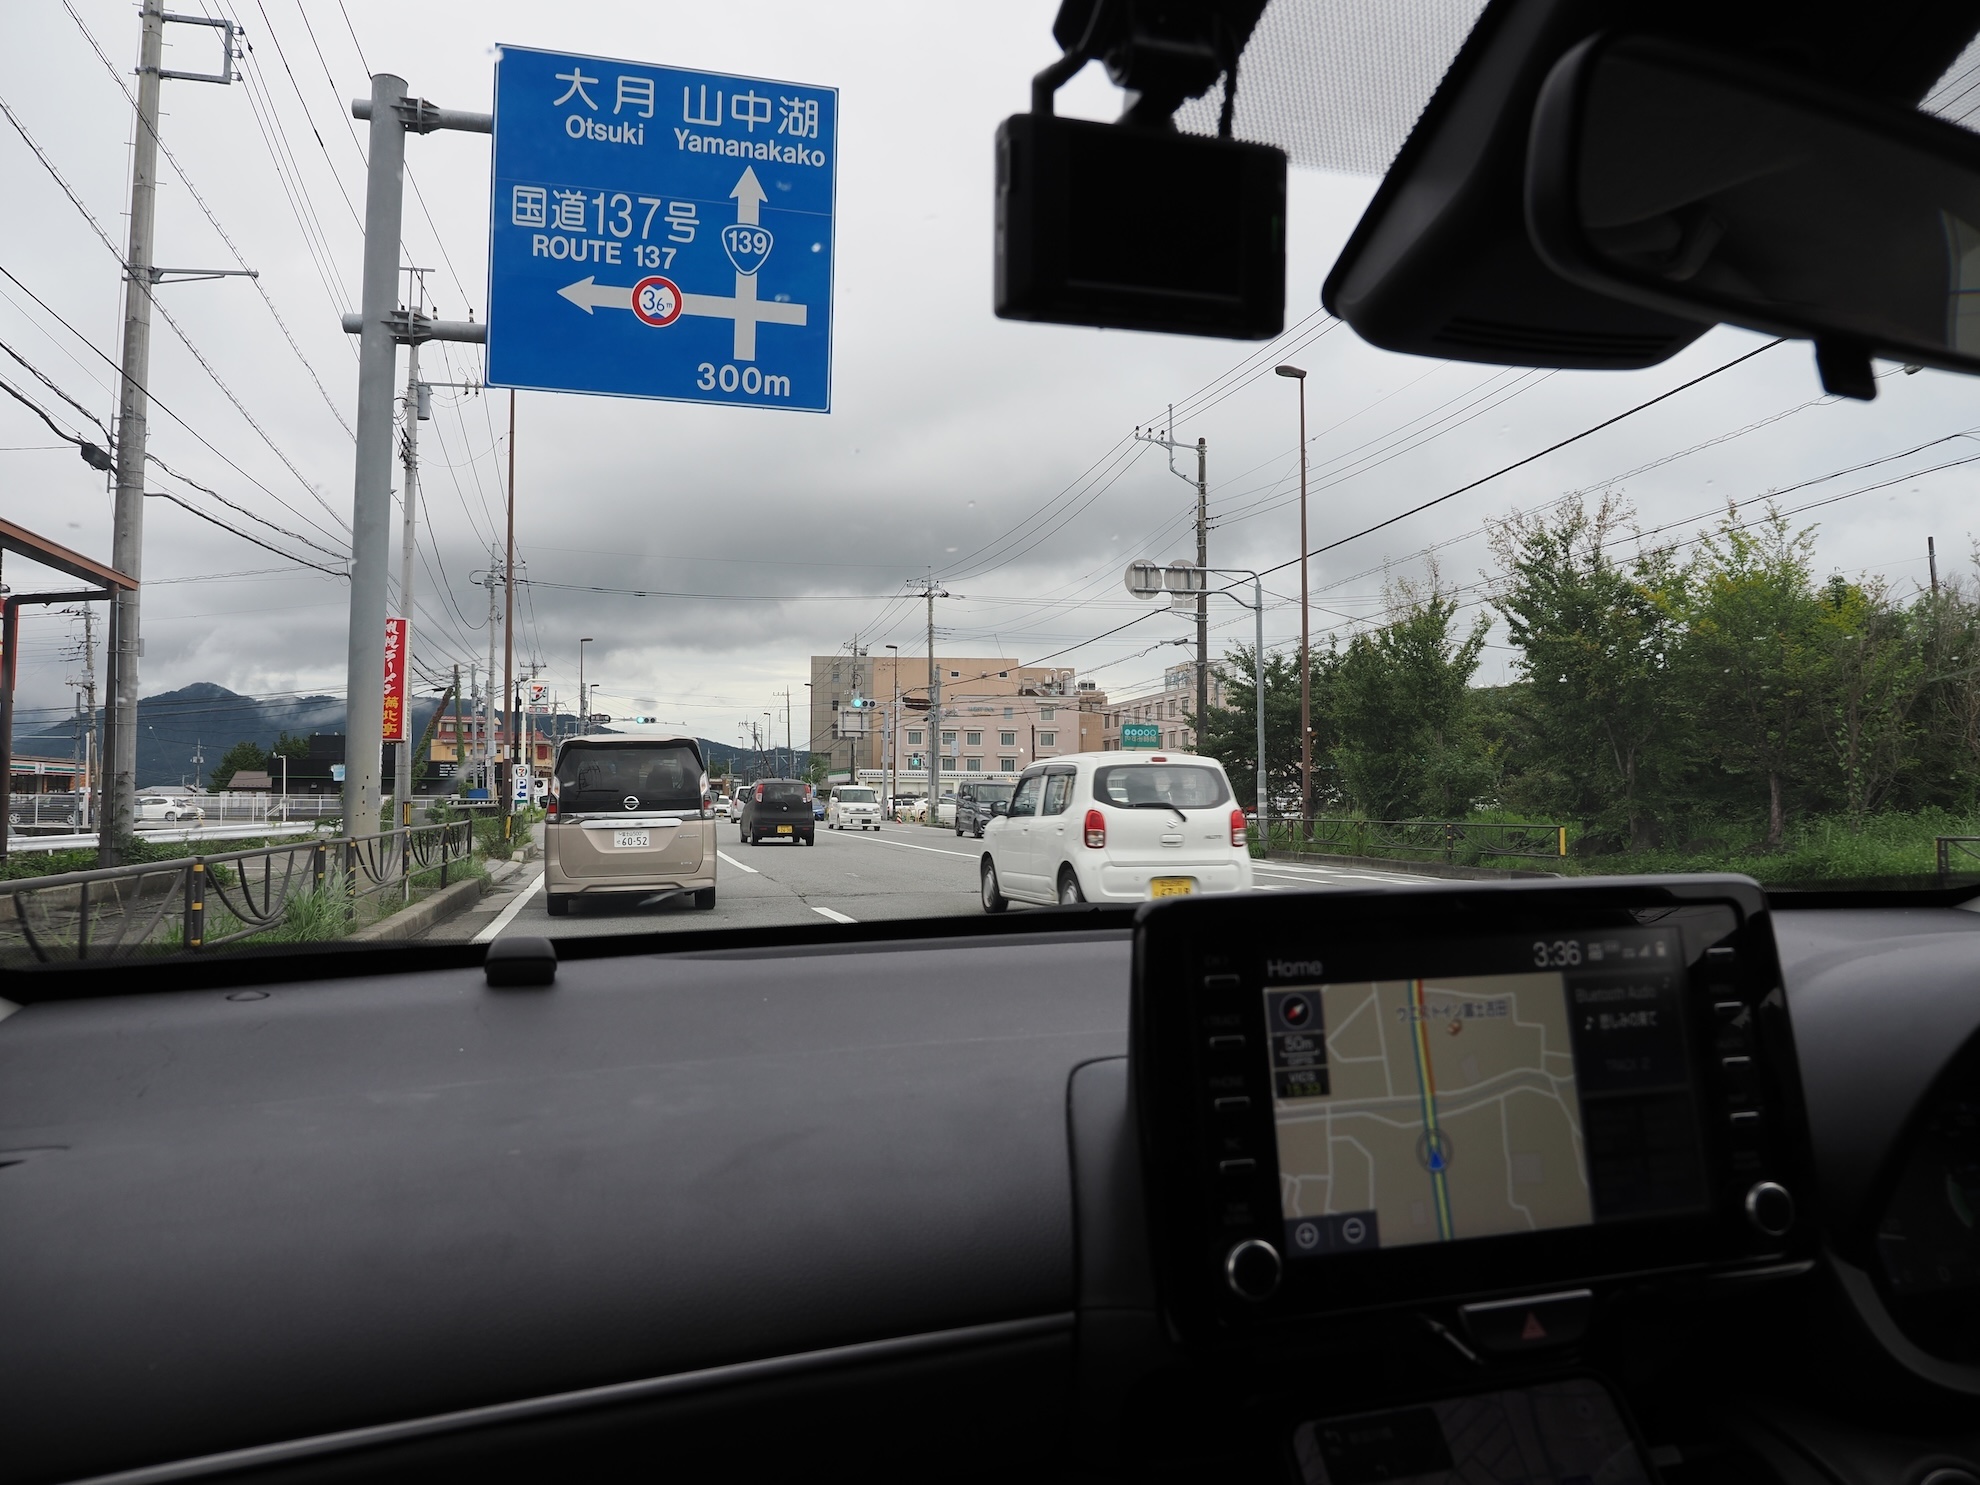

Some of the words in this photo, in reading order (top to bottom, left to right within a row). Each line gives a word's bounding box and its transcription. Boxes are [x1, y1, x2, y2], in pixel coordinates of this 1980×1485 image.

[553, 67, 655, 119] 大月
[683, 84, 819, 139] 山中湖
[565, 114, 644, 146] Otsuki
[673, 127, 826, 168] Yamanakako
[511, 184, 700, 243] 国道137号
[532, 234, 622, 265] ROUTE
[633, 246, 677, 270] 137
[728, 230, 767, 255] 139
[696, 362, 791, 397] 300m
[1266, 958, 1324, 978] Home
[1532, 941, 1581, 968] 3:36
